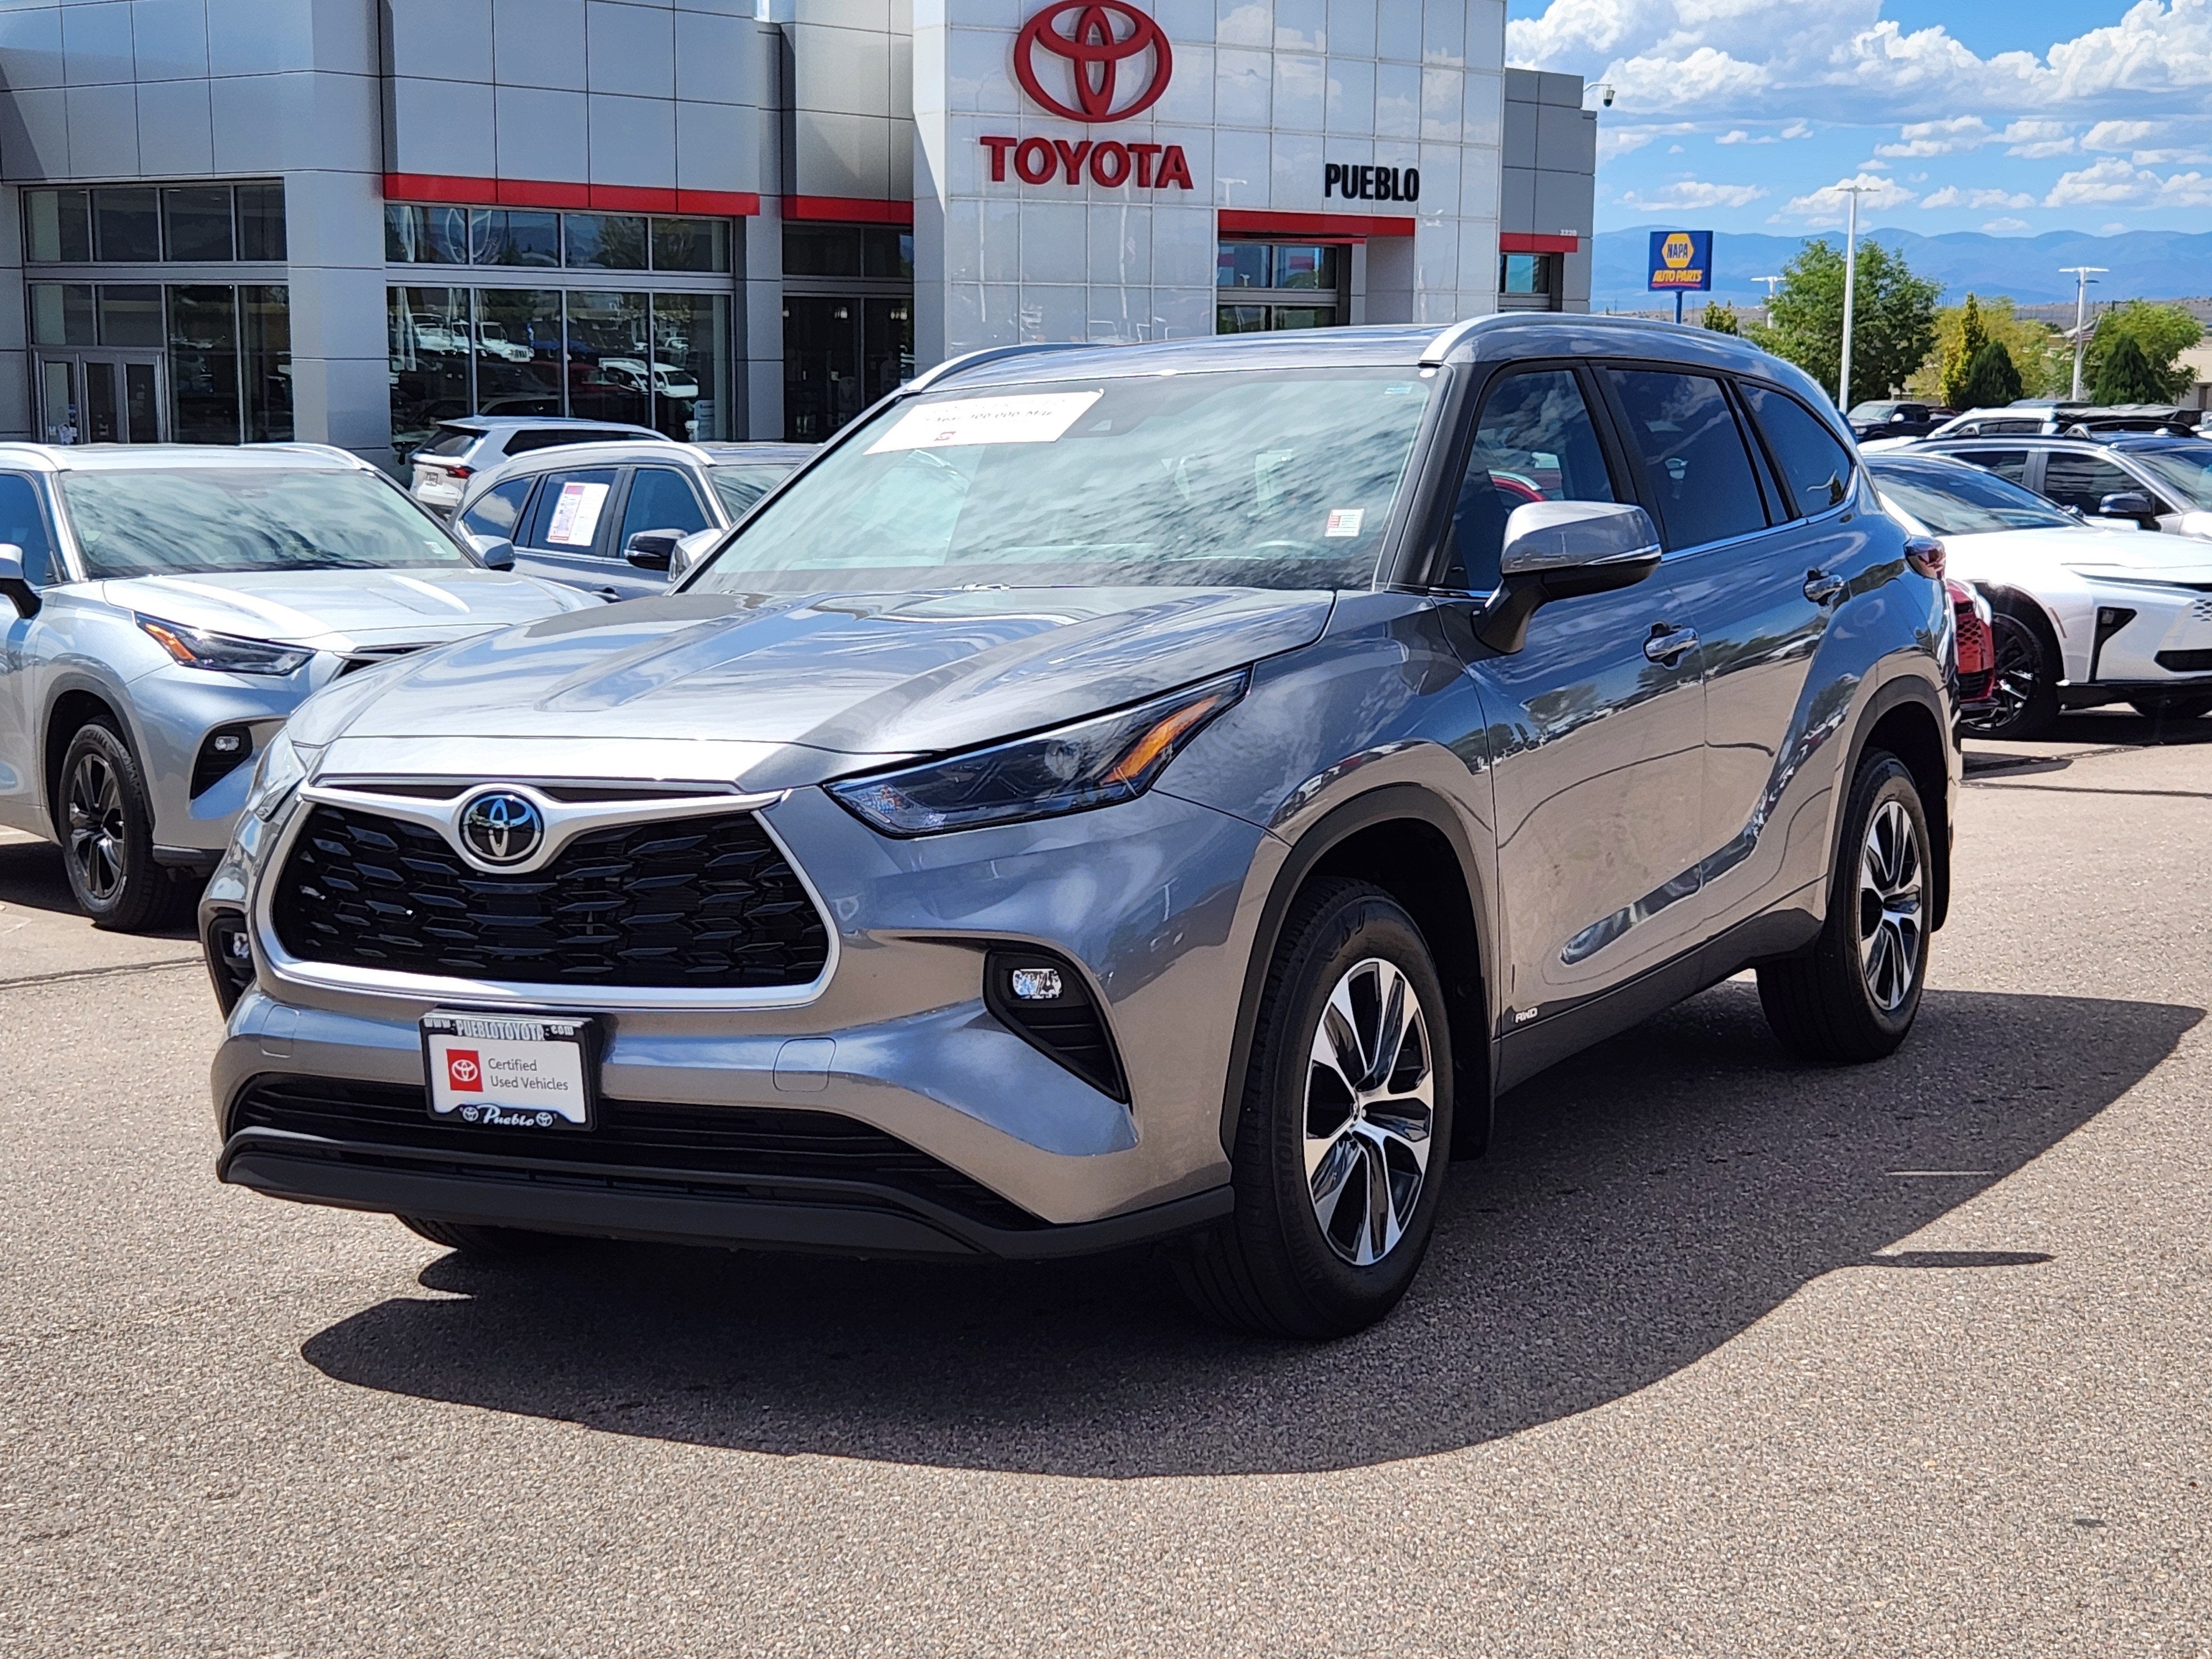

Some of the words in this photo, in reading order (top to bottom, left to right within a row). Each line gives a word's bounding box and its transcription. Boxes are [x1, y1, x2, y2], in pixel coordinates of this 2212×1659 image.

[980, 136, 1194, 190] TOYOTA
[1324, 163, 1420, 202] PUEBLO
[1667, 243, 1688, 259] NAPA
[1652, 270, 1676, 283] AUTO
[1676, 269, 1703, 283] PARTS
[1515, 1007, 1538, 1023] AWD
[488, 1057, 538, 1072] Certified
[490, 1075, 519, 1088] Used
[520, 1076, 569, 1091] Vehicles
[477, 1104, 535, 1126] Pueblo
